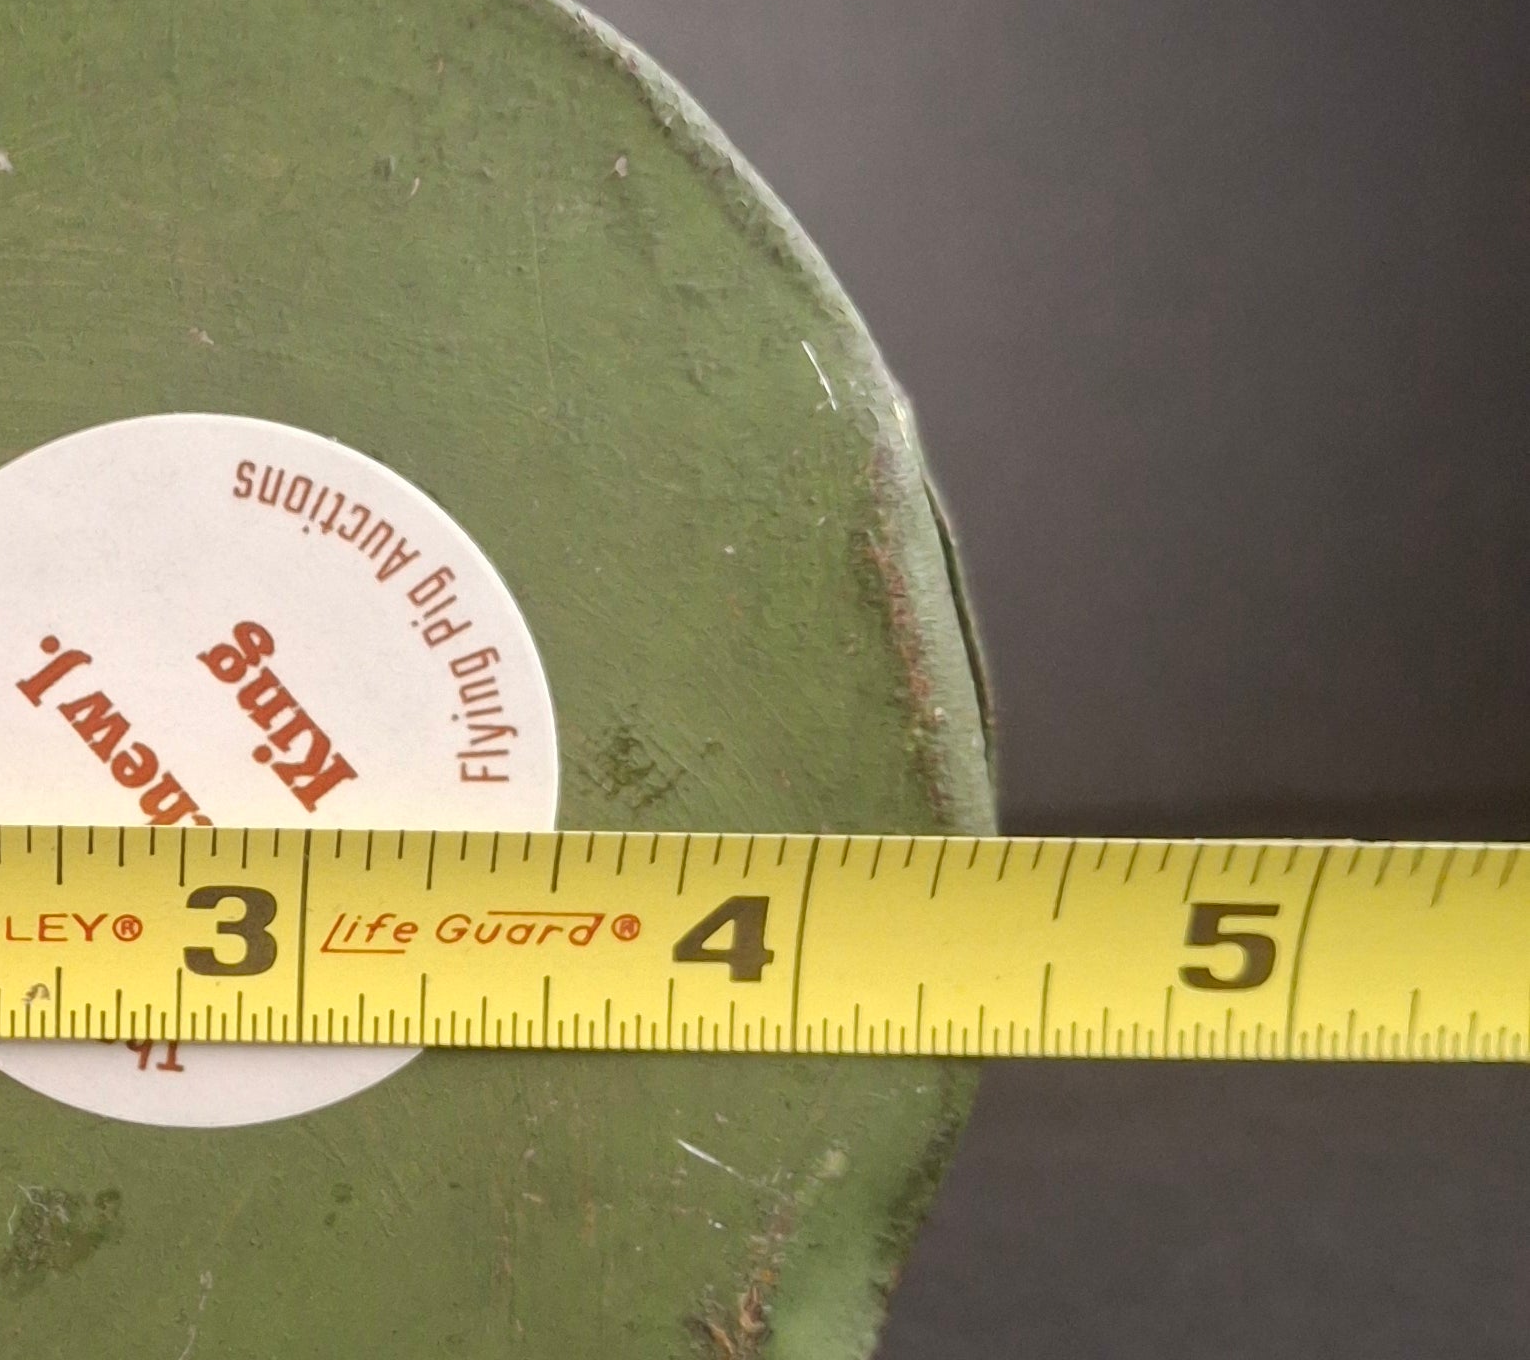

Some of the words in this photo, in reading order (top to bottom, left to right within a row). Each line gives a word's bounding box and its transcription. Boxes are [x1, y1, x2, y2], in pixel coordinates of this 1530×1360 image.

[232, 459, 421, 583] Auctions
[408, 566, 473, 649] Pig
[15, 634, 93, 708] J.
[449, 645, 519, 783] Flying
[58, 690, 214, 826] hew
[197, 620, 359, 813] King
[183, 885, 279, 977] 3
[320, 912, 420, 955] Life
[672, 895, 775, 983] 4
[1179, 902, 1281, 992] 5
[95, 1039, 184, 1072] Th
